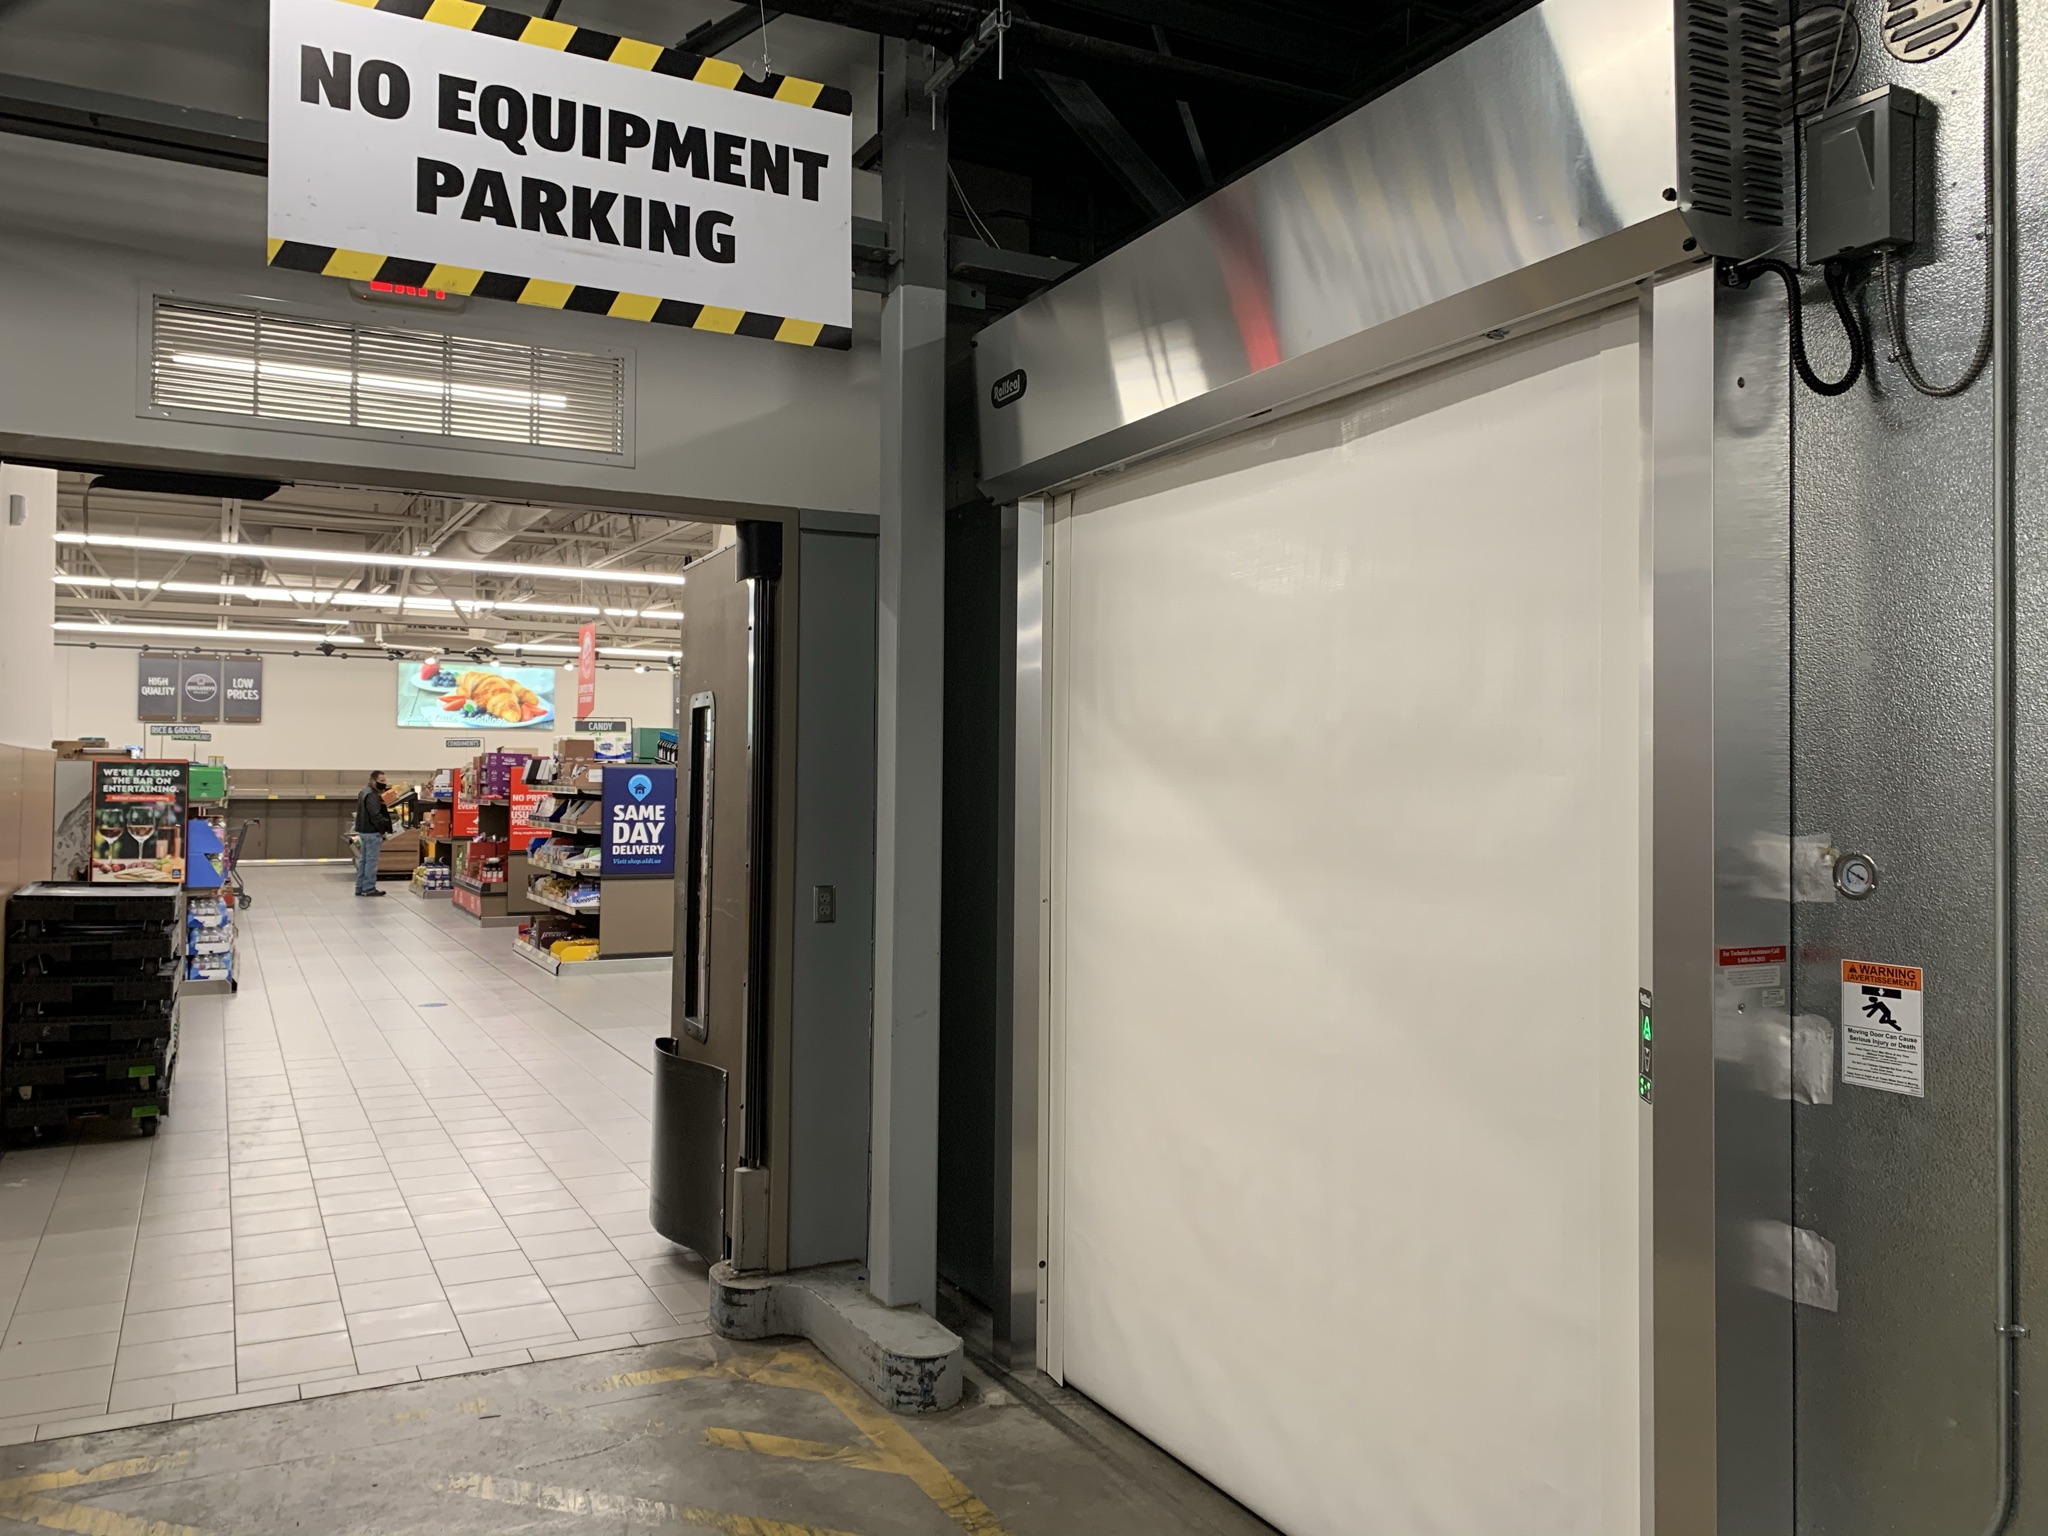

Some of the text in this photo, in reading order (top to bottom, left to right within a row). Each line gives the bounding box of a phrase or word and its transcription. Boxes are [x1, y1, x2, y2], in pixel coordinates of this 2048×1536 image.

[300, 44, 830, 202] NO EQUIPMENT
[416, 157, 736, 264] PARKING
[148, 677, 169, 686] HIGH
[232, 678, 254, 689] LOW
[141, 686, 175, 696] QUALITY
[226, 689, 260, 701] PRICES
[151, 726, 200, 734] RICE & GRAINS
[588, 722, 613, 731] CANDY
[103, 768, 180, 777] WE'RE RAISING
[133, 777, 153, 785] BAR
[156, 777, 171, 785] ON
[103, 785, 179, 793] ENTERTAINING.
[511, 811, 529, 819] USU
[613, 804, 666, 821] SAME
[612, 822, 665, 844] DAY
[612, 844, 665, 855] DELIVERY
[1859, 964, 1916, 980] WARNING
[1847, 973, 1917, 990] (AVERTISSEMENT)
[1848, 1027, 1869, 1037] Moving
[1899, 1035, 1918, 1043] Cause
[1849, 1034, 1871, 1043] Serious
[1872, 1038, 1889, 1047] Injury
[1898, 1042, 1916, 1050] Death
